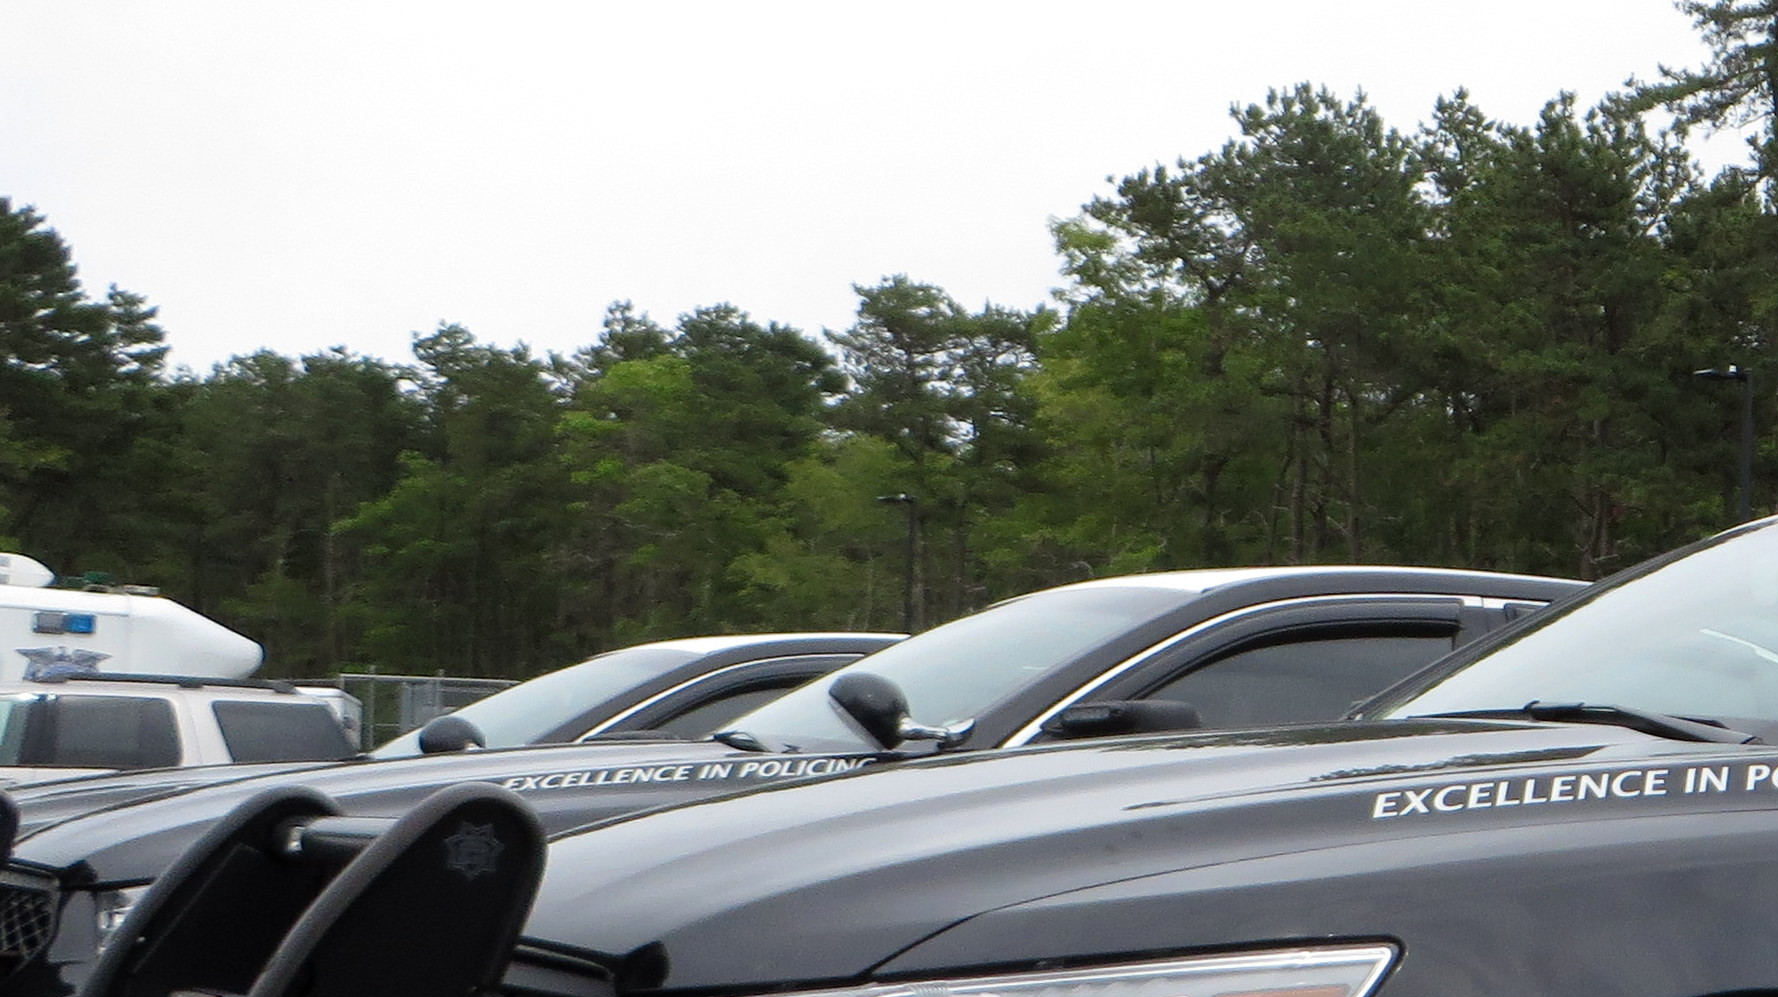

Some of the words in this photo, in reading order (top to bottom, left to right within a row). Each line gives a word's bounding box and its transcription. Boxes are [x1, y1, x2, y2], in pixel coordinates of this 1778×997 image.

[504, 765, 691, 791] EXCELLENCE
[699, 764, 734, 780] IN
[1372, 769, 1670, 819] EXCELLENCE
[1683, 765, 1730, 794] IN
